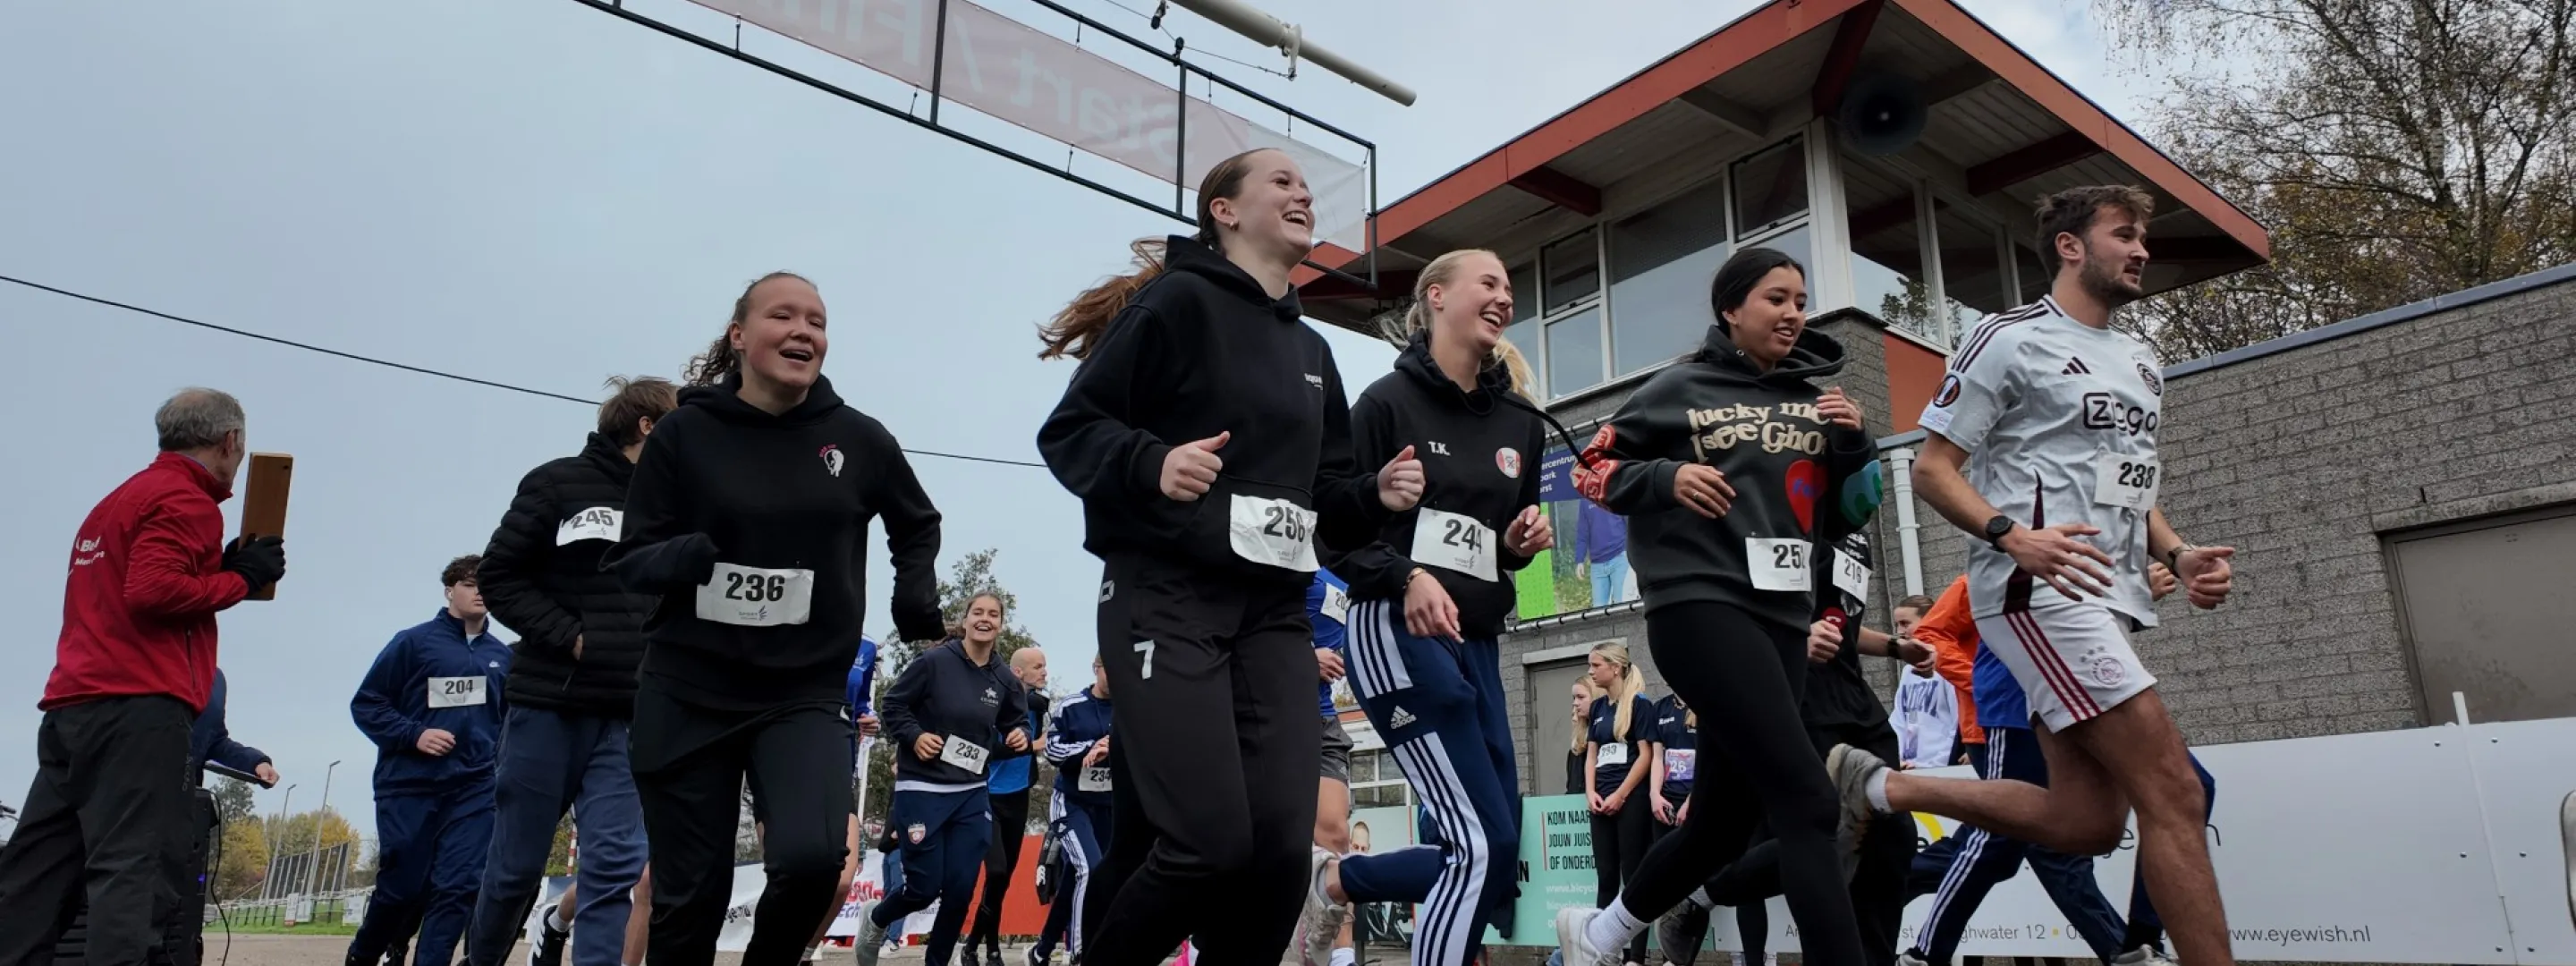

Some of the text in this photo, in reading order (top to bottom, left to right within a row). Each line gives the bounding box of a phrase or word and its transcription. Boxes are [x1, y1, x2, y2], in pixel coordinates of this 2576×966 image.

[1686, 402, 1772, 431] lucky
[1702, 422, 1759, 450] see
[2118, 462, 2156, 490] 238
[570, 510, 614, 530] 245
[1264, 506, 1305, 543] 256
[725, 572, 785, 602] 236
[1133, 640, 1156, 680] 7
[445, 679, 473, 695] 204
[955, 742, 980, 760] 233
[1547, 810, 1566, 826] KOM
[1548, 831, 1592, 848] JOUW JUIS
[1550, 855, 1559, 870] OF
[1546, 881, 1598, 895] www.bicycl
[2025, 924, 2046, 940] 12
